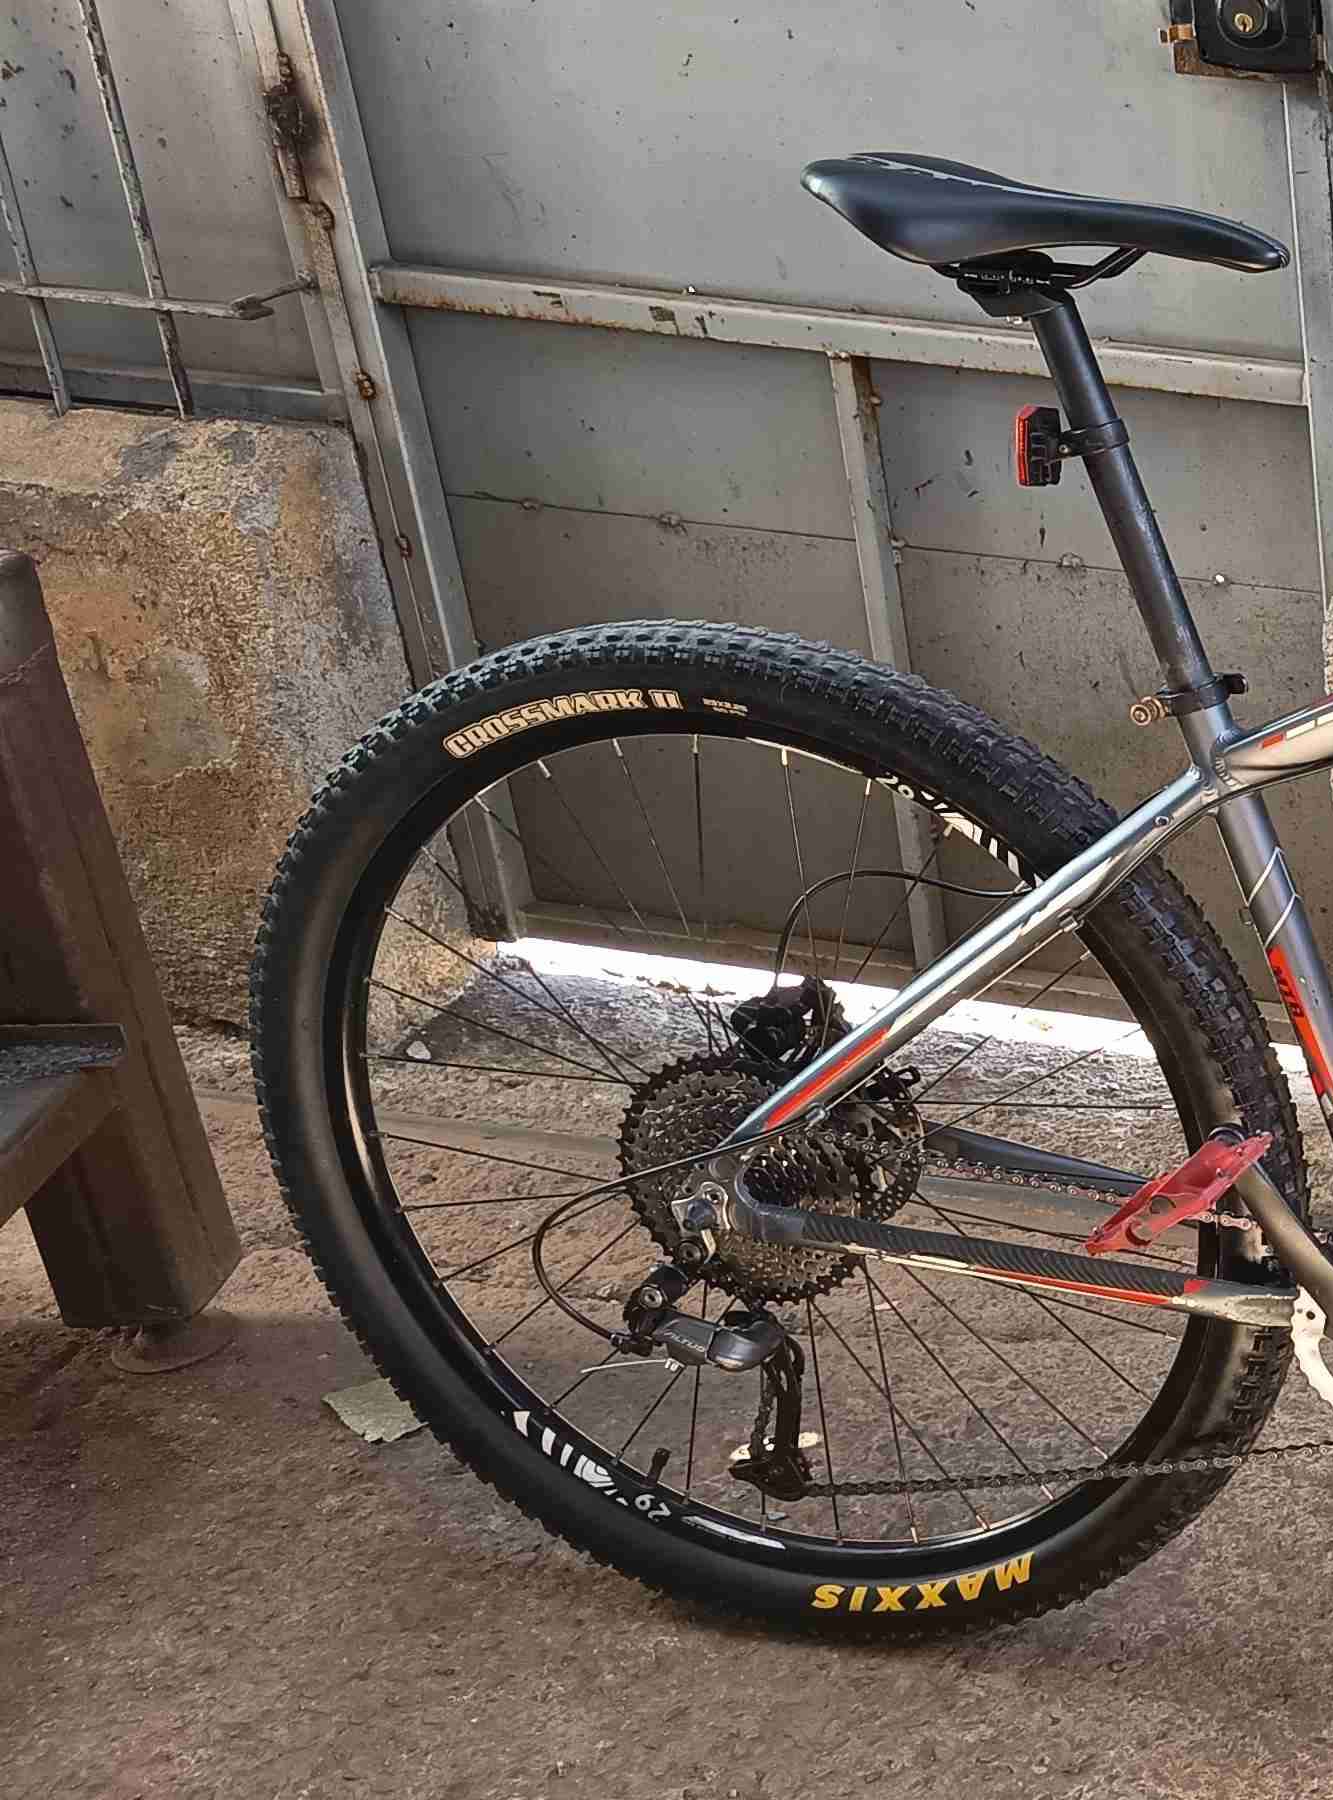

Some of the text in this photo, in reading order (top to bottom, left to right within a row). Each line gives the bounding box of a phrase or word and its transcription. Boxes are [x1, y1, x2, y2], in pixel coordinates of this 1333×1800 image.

[442, 689, 649, 759] CROSSMARK
[648, 689, 684, 710] II
[633, 1493, 672, 1522] 29
[811, 1551, 1035, 1613] MAXXIS
